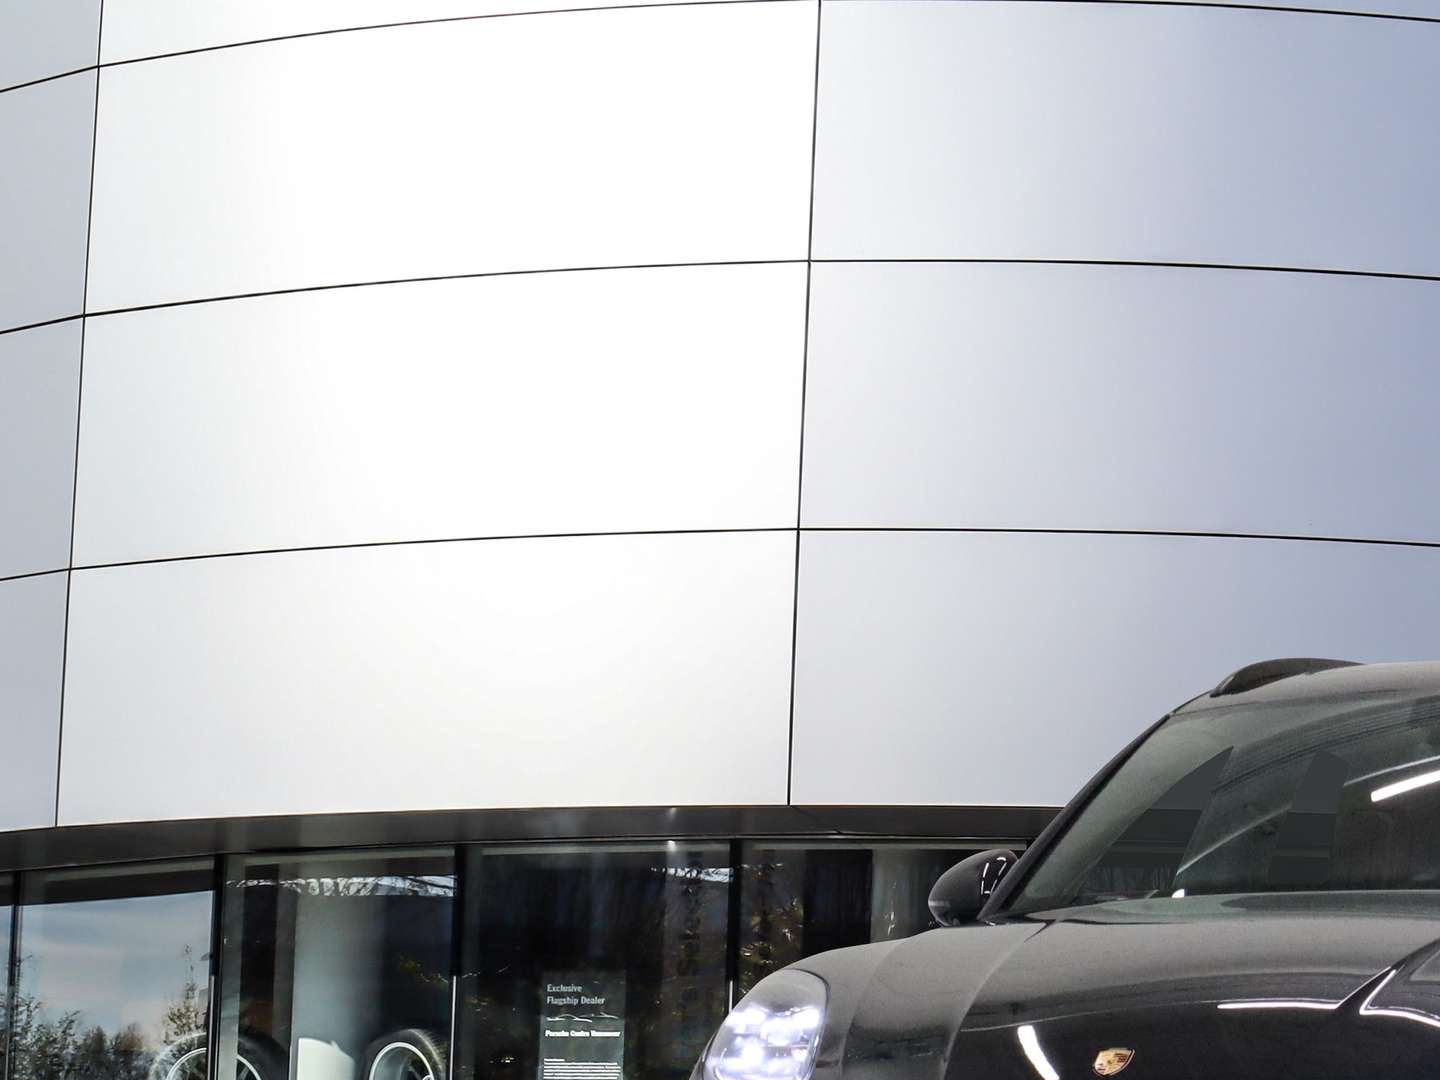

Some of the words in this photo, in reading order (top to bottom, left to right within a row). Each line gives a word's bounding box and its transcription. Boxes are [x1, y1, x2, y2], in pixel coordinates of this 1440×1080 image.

[546, 984, 583, 993] Exclusive
[546, 996, 578, 1005] Flagship
[580, 996, 605, 1004] Dealer
